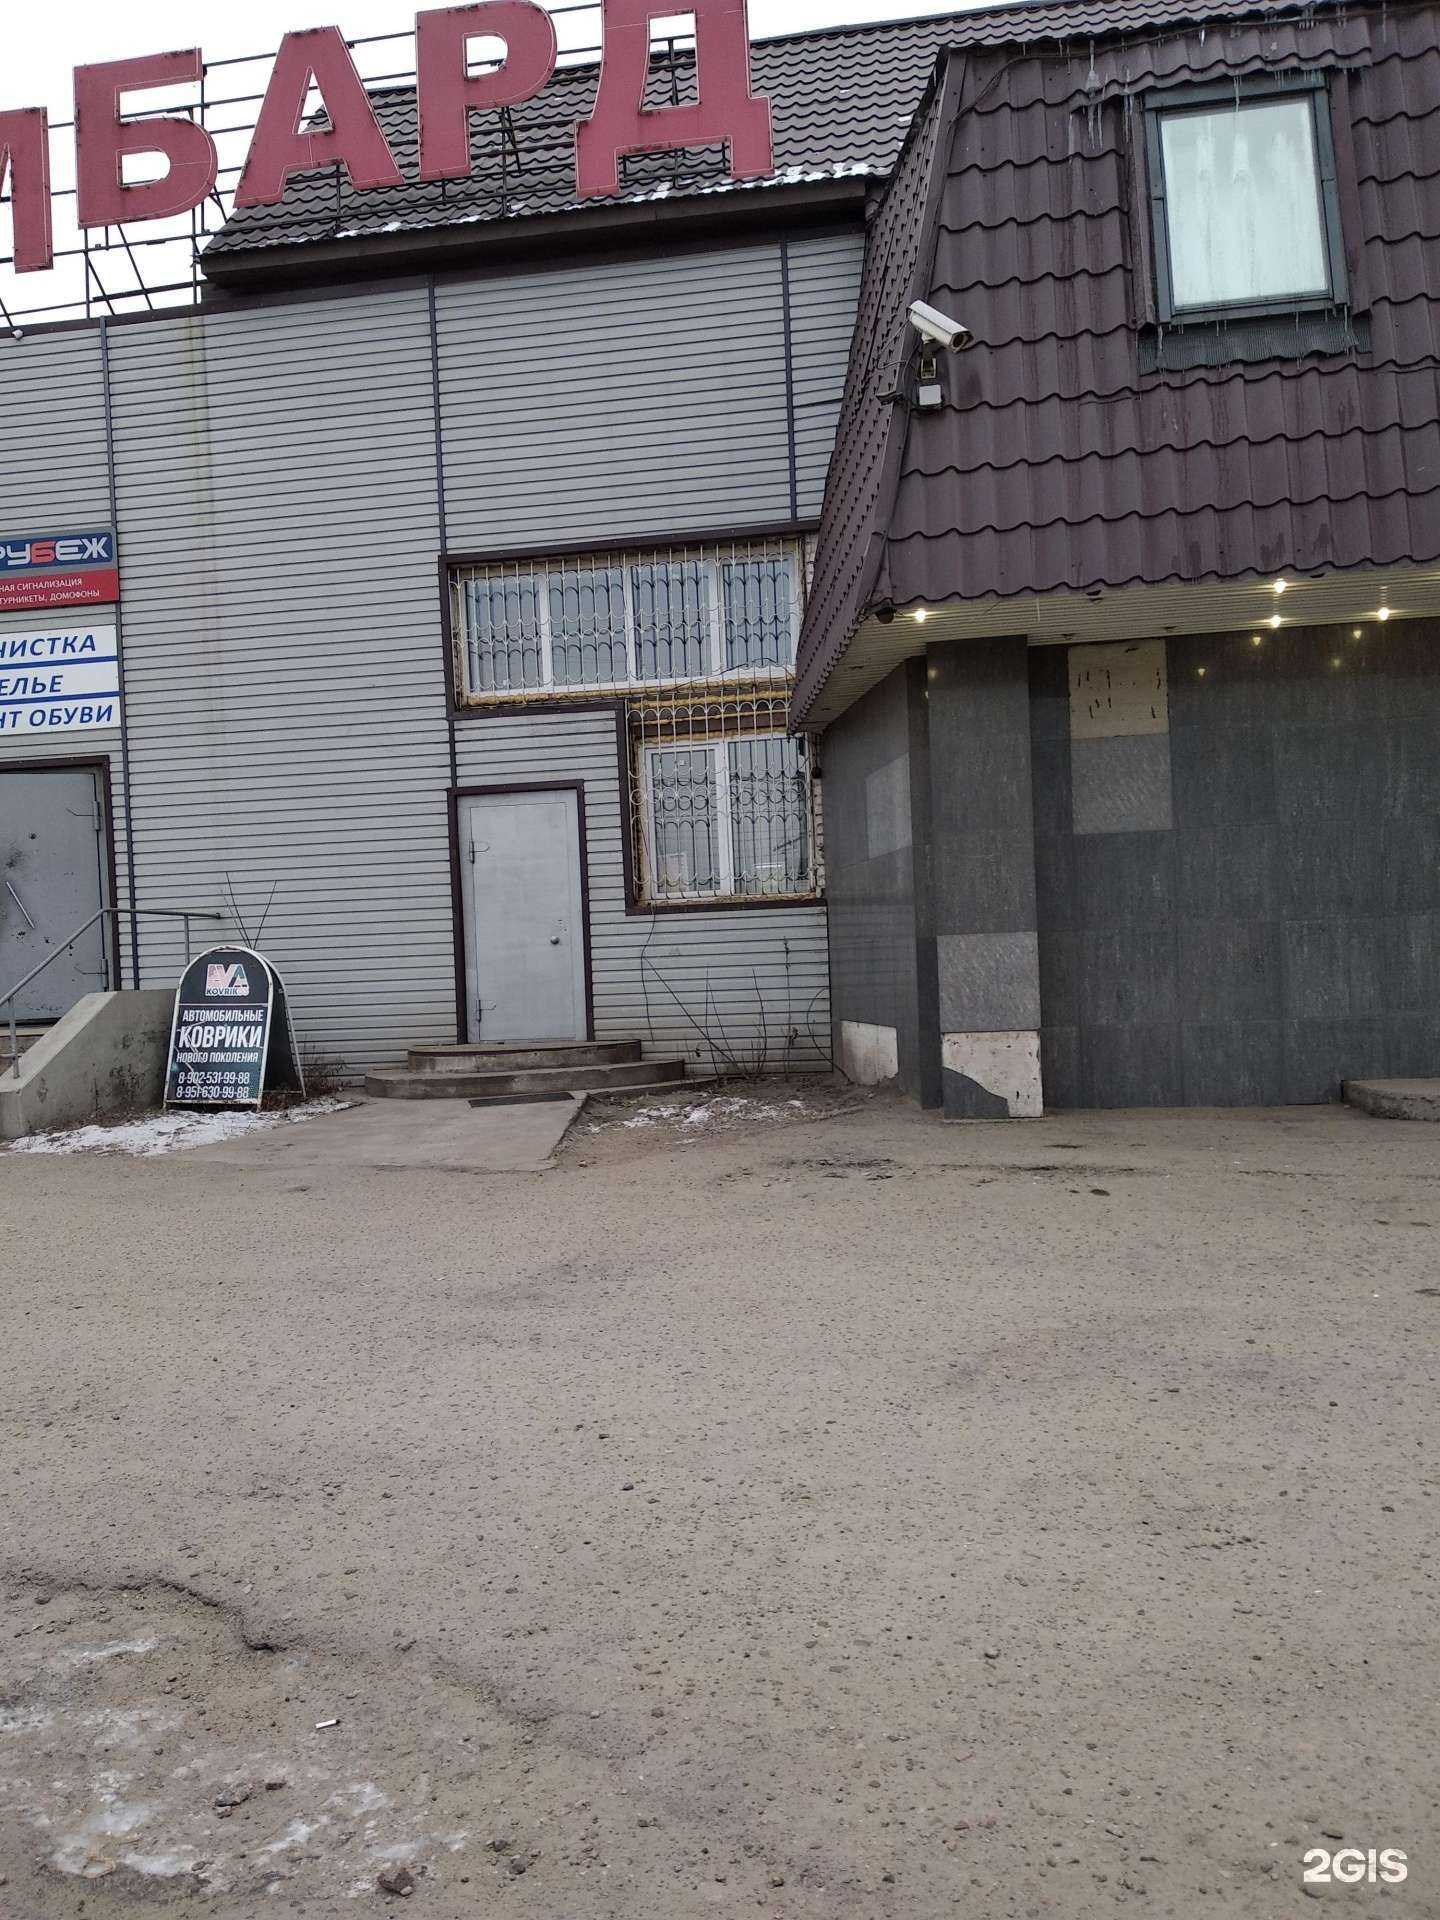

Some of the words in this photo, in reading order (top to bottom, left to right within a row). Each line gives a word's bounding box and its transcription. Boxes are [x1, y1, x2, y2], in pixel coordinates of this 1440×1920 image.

[17, 578, 82, 591] СИГНАЛИЗАЦИЯ
[50, 589, 100, 602] ДОМОФОНЫ
[29, 705, 113, 727] ОБУВИ
[182, 1009, 264, 1022] АВТОМОБИЛЬНЫЕ
[178, 1025, 263, 1048] КОВРИКИ
[176, 1052, 208, 1063] НОВОГО
[209, 1051, 259, 1063] ПОКОЛЕНИЯ
[178, 1071, 250, 1085] 8-902-531-99-88
